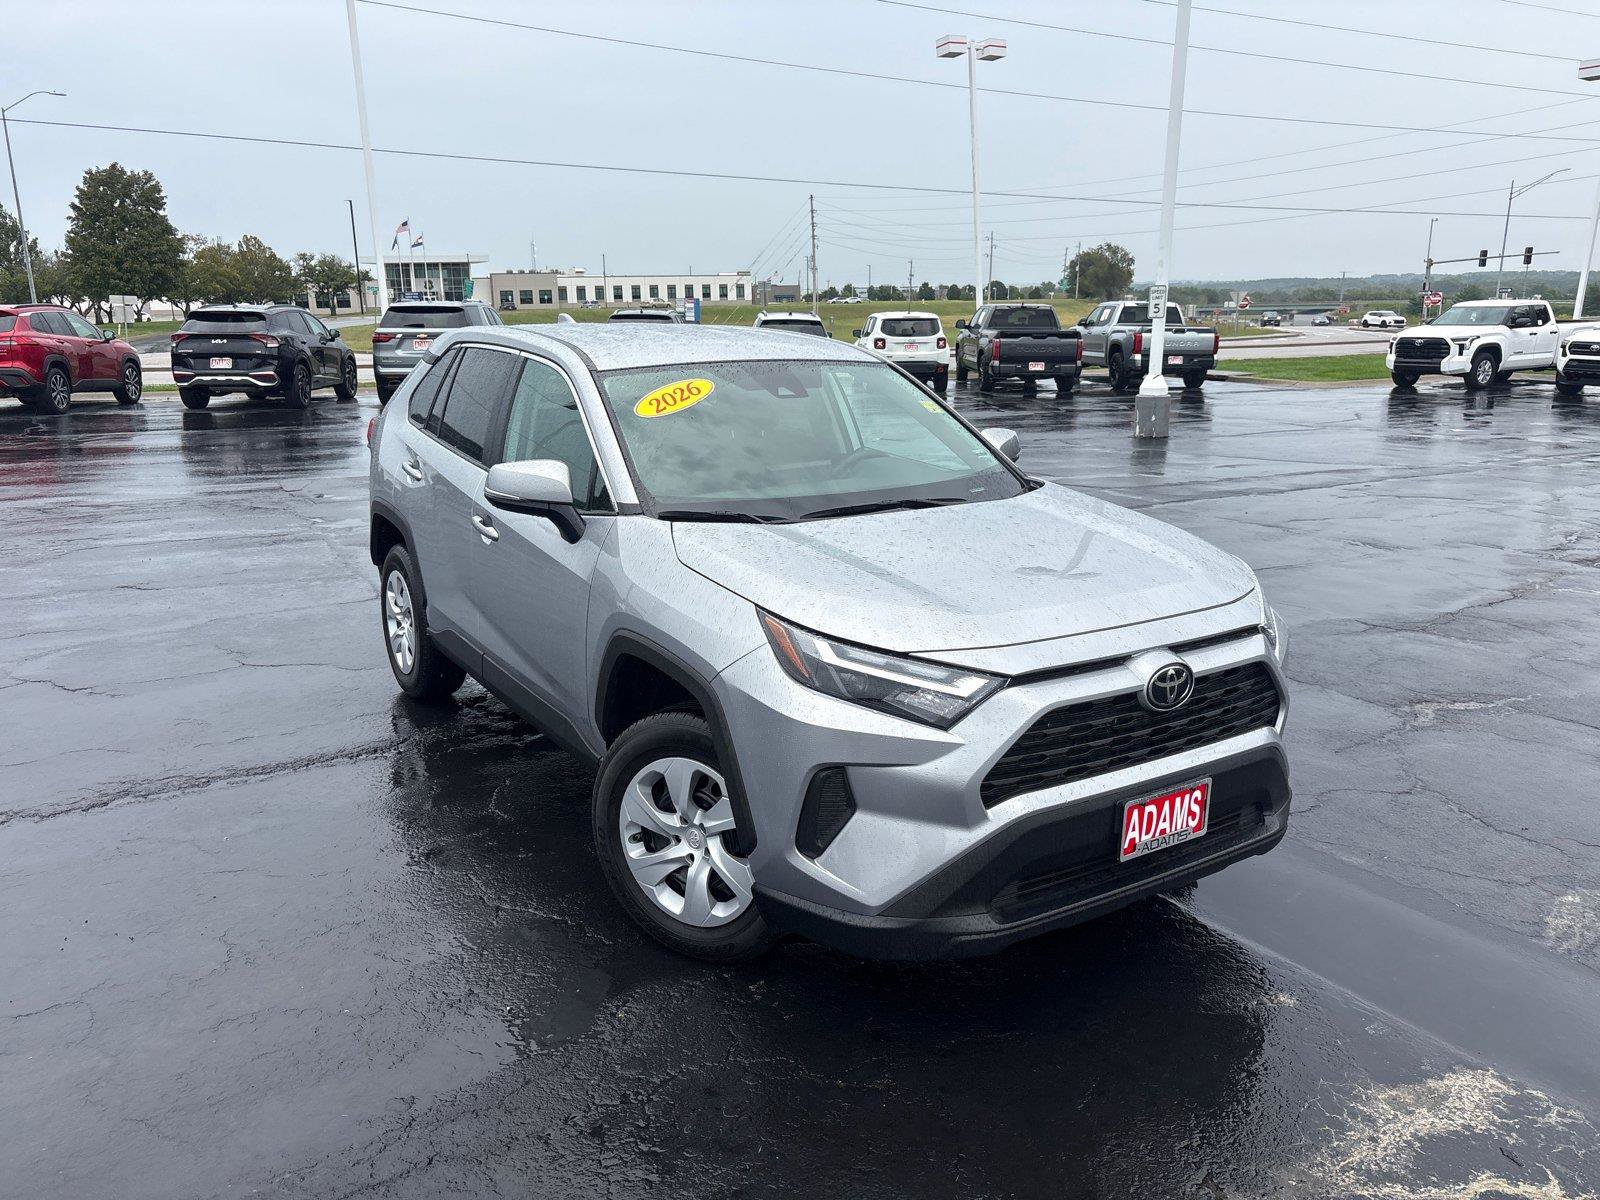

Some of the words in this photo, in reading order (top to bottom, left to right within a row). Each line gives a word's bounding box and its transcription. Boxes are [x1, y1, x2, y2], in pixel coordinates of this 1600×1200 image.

[1153, 303, 1160, 314] 5
[211, 359, 232, 367] ADAMS
[648, 381, 702, 414] 2026
[1123, 789, 1202, 849] ADAMS
